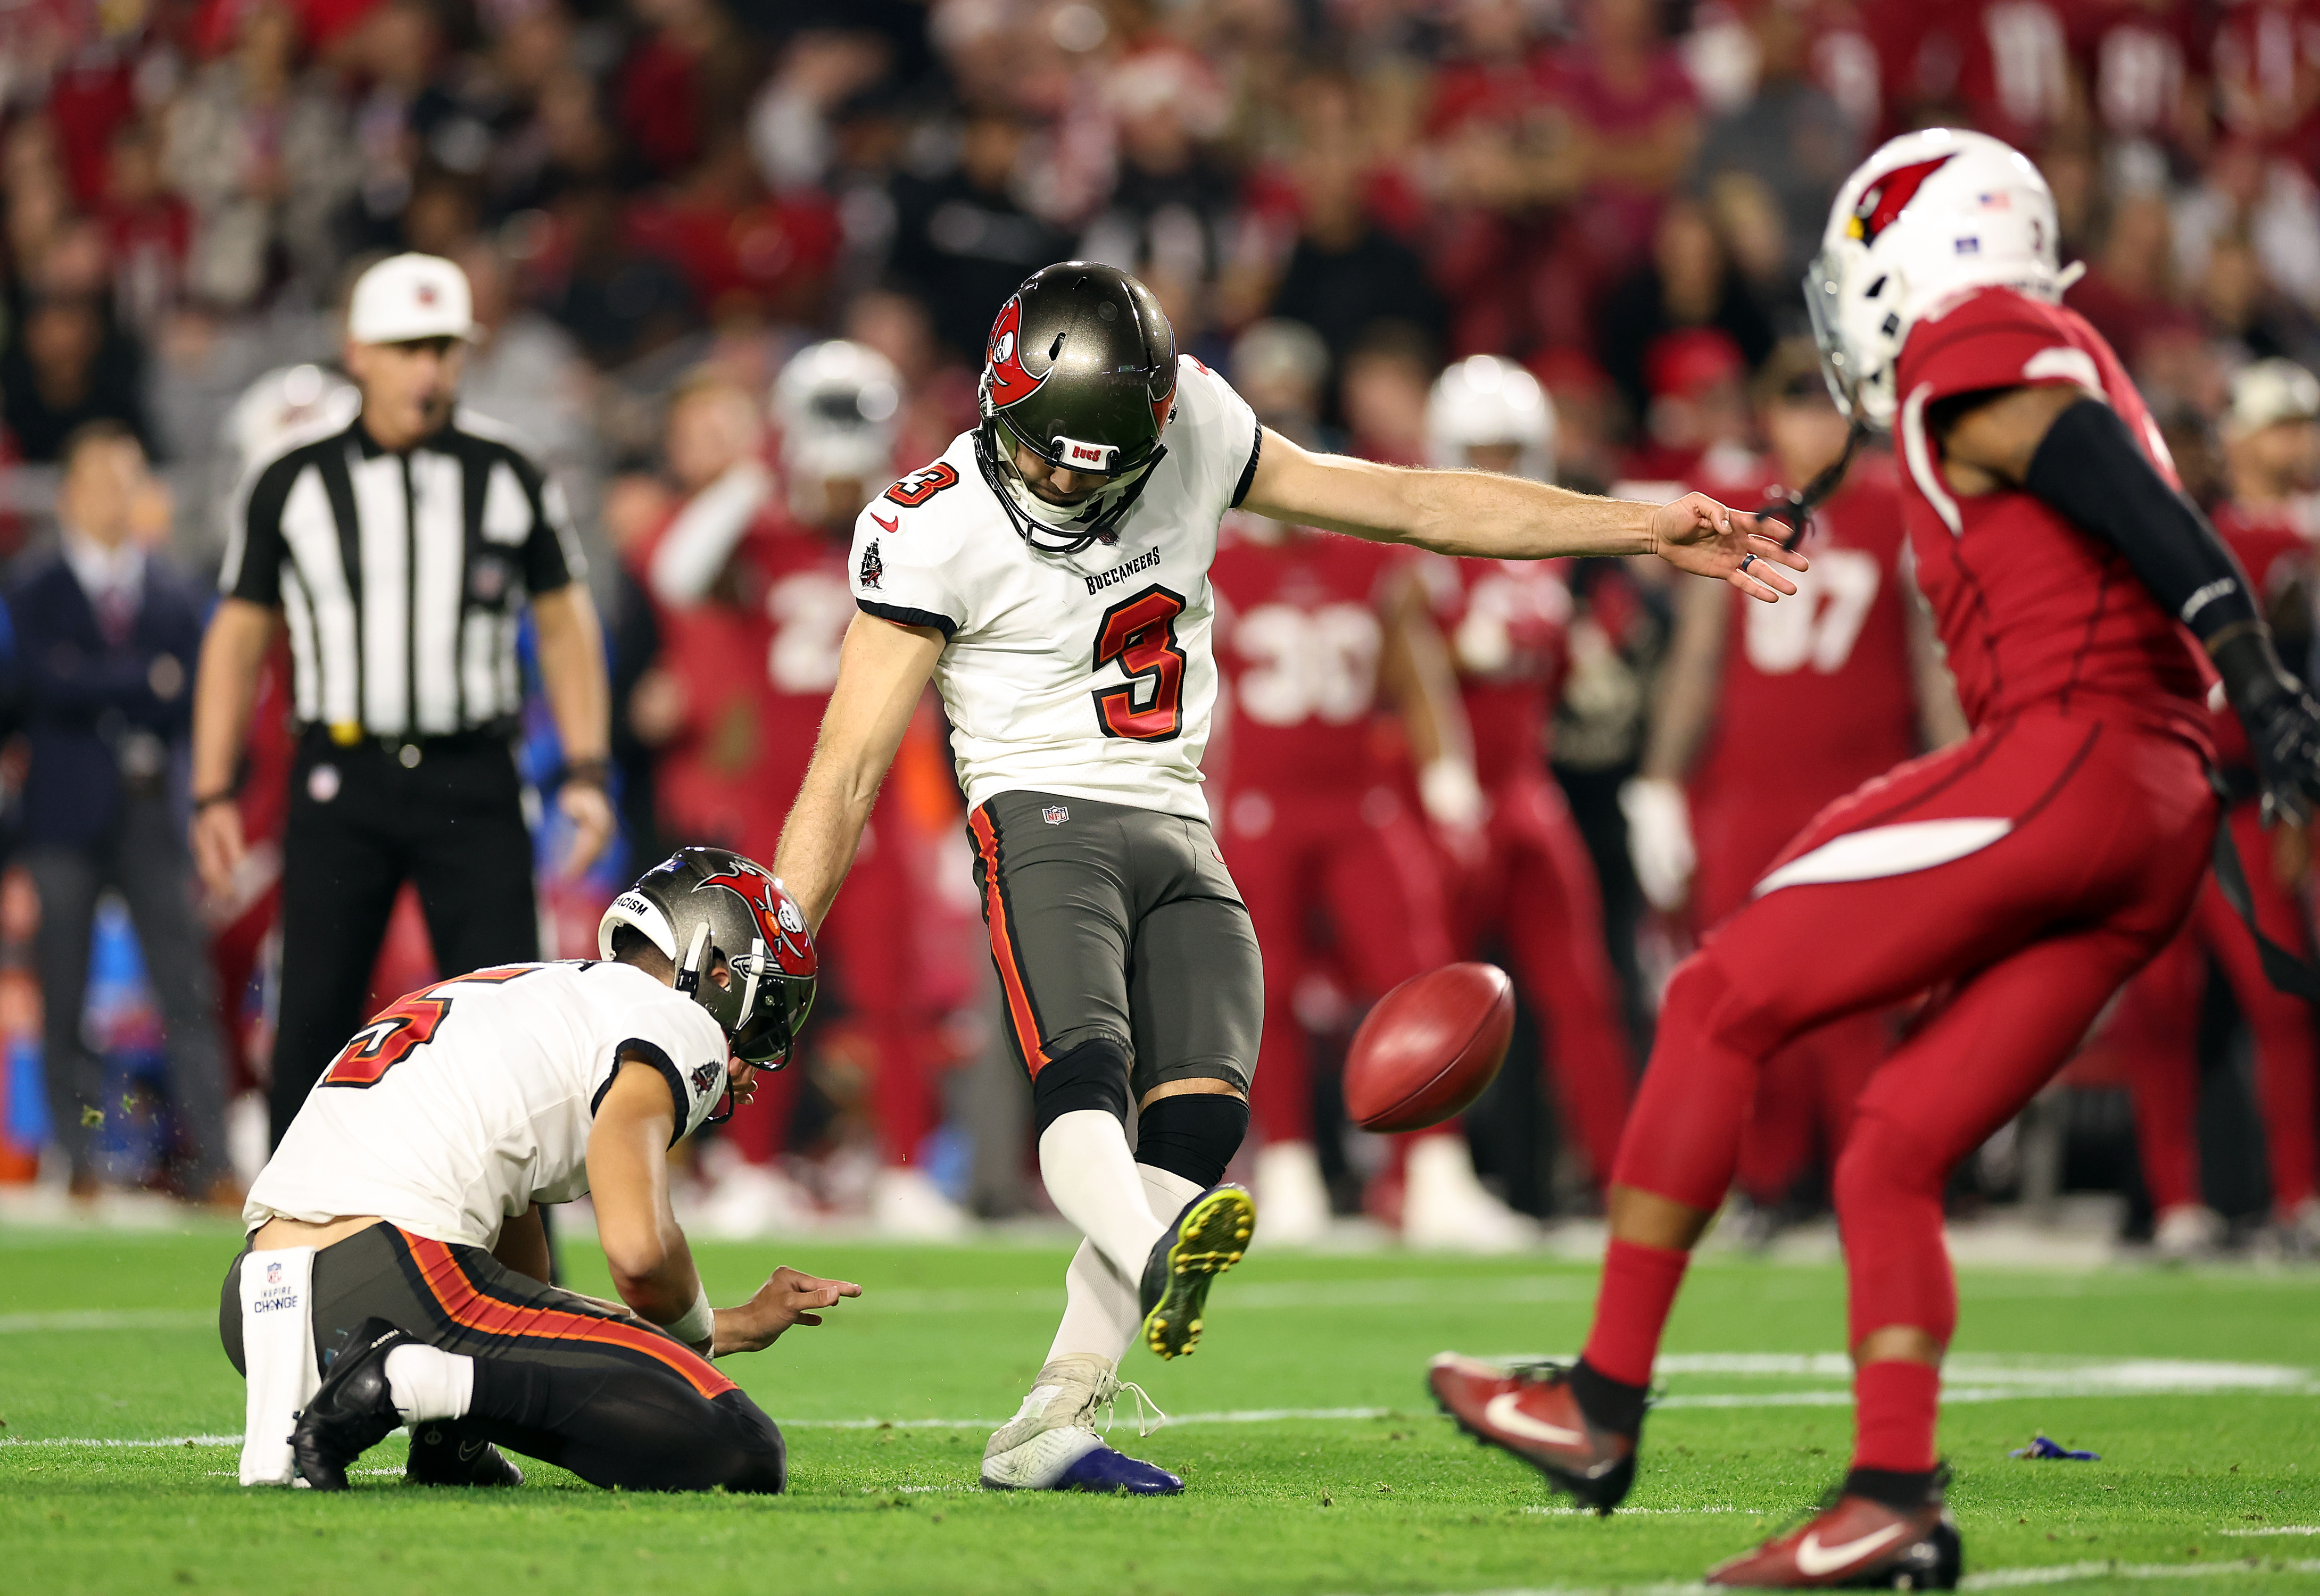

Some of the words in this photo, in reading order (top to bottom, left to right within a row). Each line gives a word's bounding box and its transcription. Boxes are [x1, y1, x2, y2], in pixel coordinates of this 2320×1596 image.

[883, 461, 959, 508] 3
[1084, 546, 1161, 595] BUCCANEERS
[1092, 583, 1187, 743] 3
[254, 1295, 297, 1313] CHANGE
